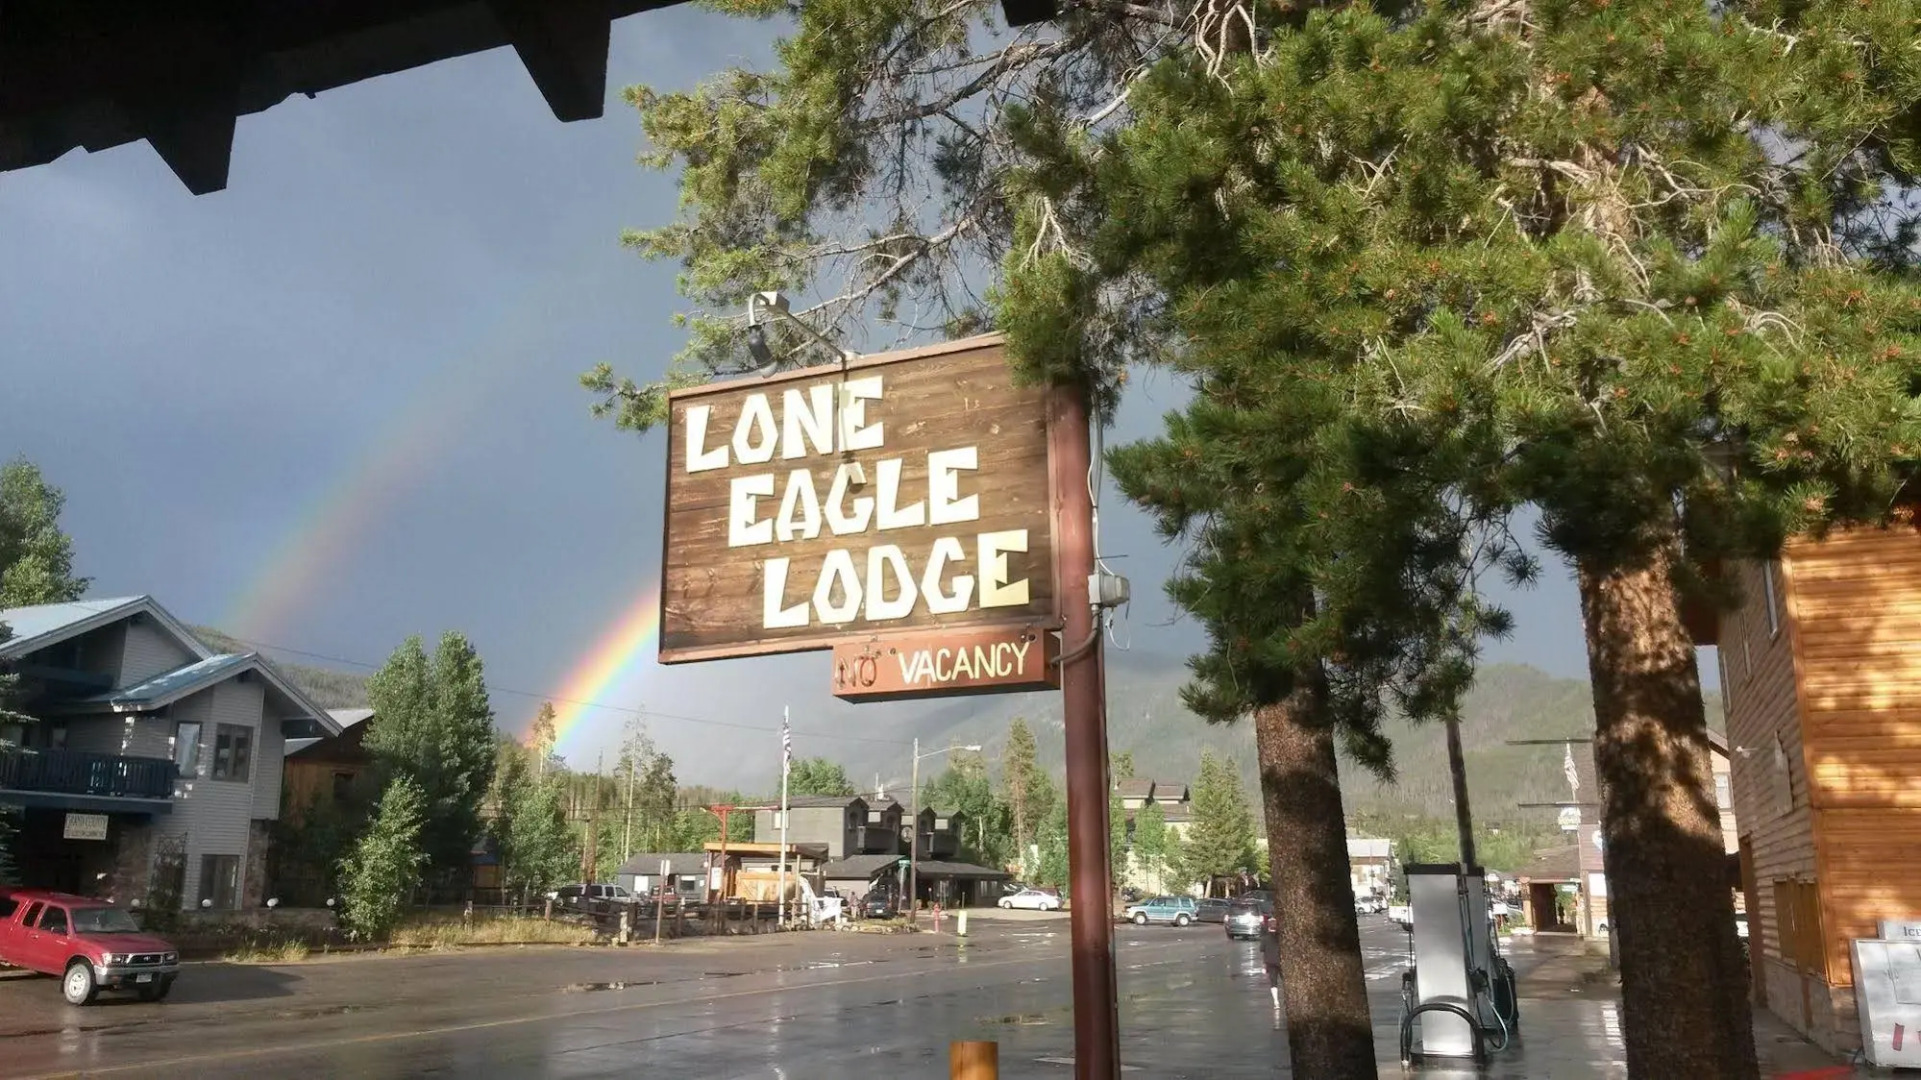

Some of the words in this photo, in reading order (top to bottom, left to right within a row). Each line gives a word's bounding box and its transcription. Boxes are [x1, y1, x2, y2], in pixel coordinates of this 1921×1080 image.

[685, 376, 884, 473] LONE
[729, 446, 979, 547] EAGLE
[763, 529, 1030, 629] LODGE
[835, 655, 877, 688] NO
[898, 642, 1030, 684] VACANCY
